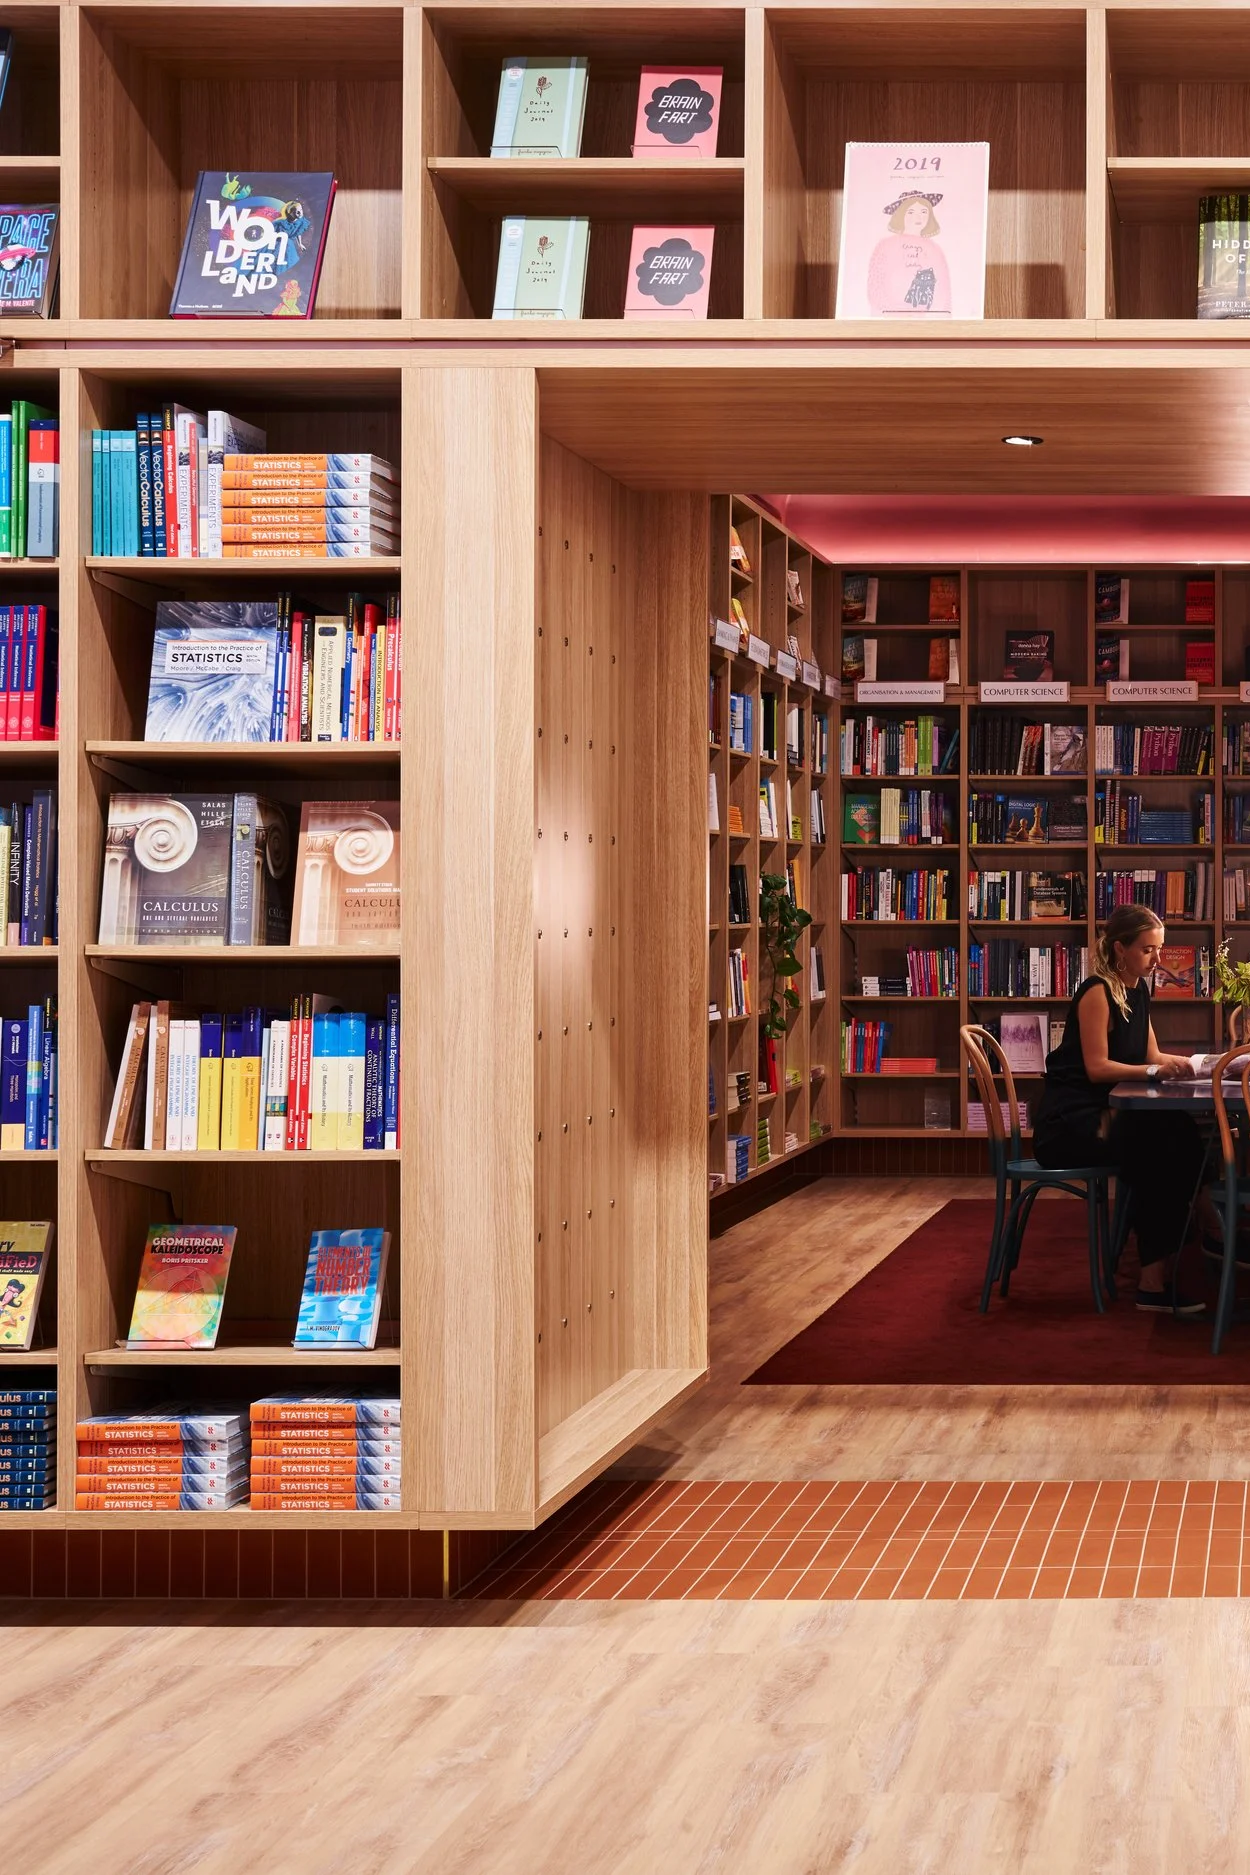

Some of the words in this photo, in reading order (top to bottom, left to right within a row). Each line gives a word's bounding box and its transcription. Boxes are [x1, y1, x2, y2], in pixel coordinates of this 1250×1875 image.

[658, 95, 702, 110] BRAIN
[659, 112, 698, 124] FART
[893, 157, 941, 171] 2019
[0, 214, 55, 252] PACE
[650, 256, 693, 269] BRAIN
[1225, 255, 1246, 263] OF
[650, 273, 688, 285] FART
[252, 479, 300, 487] STATISTICS
[209, 467, 217, 529] EXPERIMENTS
[253, 549, 301, 557] STATISTICS
[171, 653, 242, 662] STATISTICS
[984, 688, 1029, 696] COMPUTER
[1031, 688, 1064, 696] SCIENCE
[1112, 687, 1158, 695] COMPUTER
[1160, 686, 1193, 695] SCIENCE
[10, 842, 21, 886] INFINITY
[240, 850, 250, 909] CALCULUS
[143, 902, 218, 911] CALCULUS
[152, 1238, 224, 1247] GEOMETRICAL
[151, 1245, 224, 1255] KALEIDOSCOPE
[315, 1258, 371, 1276] NUMBER
[314, 1276, 369, 1296] THEORY
